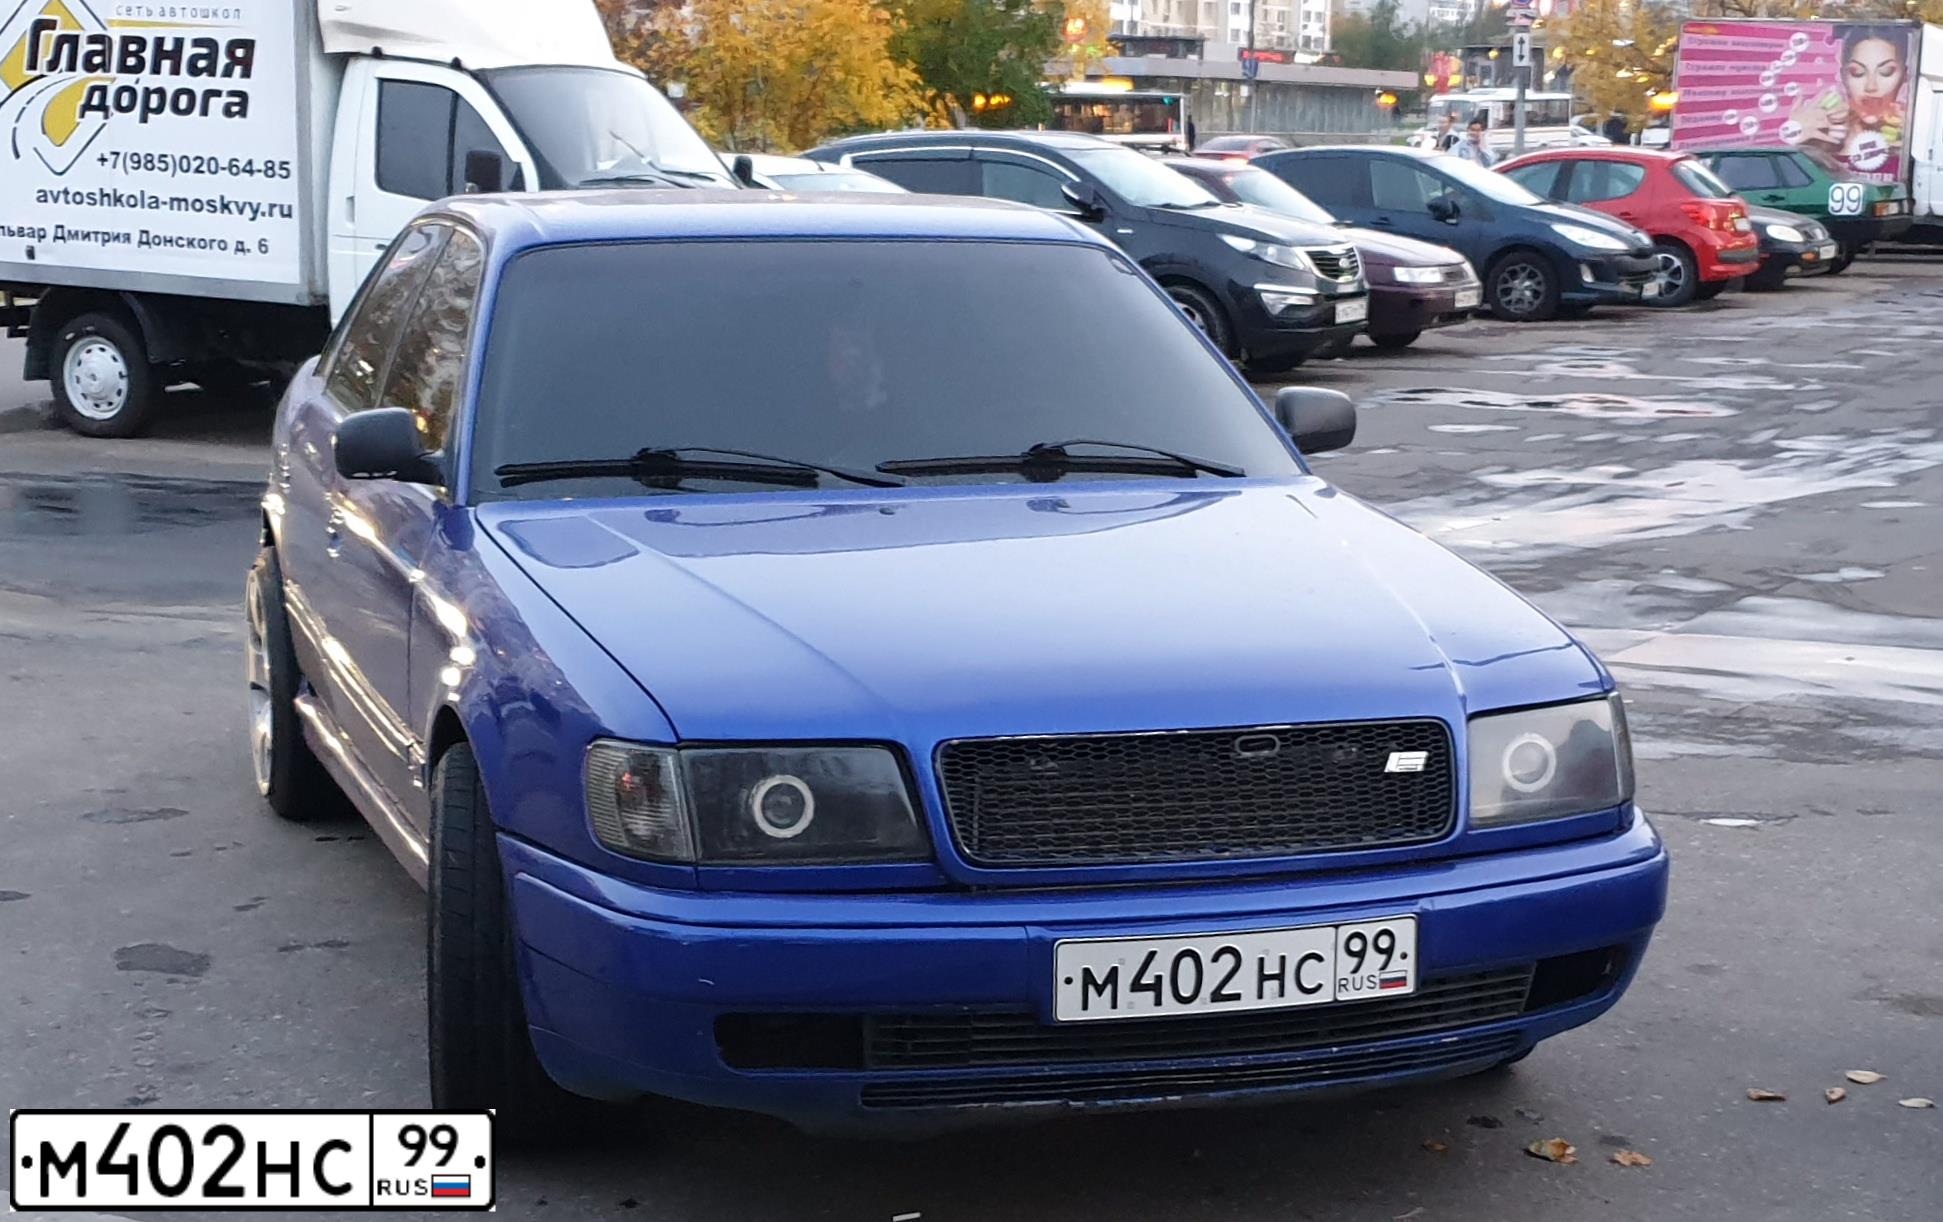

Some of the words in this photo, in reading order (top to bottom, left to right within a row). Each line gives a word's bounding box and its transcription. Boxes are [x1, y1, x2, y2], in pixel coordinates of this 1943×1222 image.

[116, 4, 153, 17] сеть
[159, 5, 241, 19] автошкол
[26, 18, 256, 79] Главная
[79, 82, 249, 123] дорога
[97, 151, 292, 179] +7(985)020-64-85
[36, 188, 294, 222] avtoshkola-moskvy.ru
[1830, 185, 1861, 213] 99
[53, 224, 132, 246] Дмитрия
[137, 229, 228, 252] Донского
[233, 242, 251, 255] д.
[257, 239, 270, 254] 6
[1344, 928, 1396, 974] 99
[1338, 974, 1378, 993] RUS
